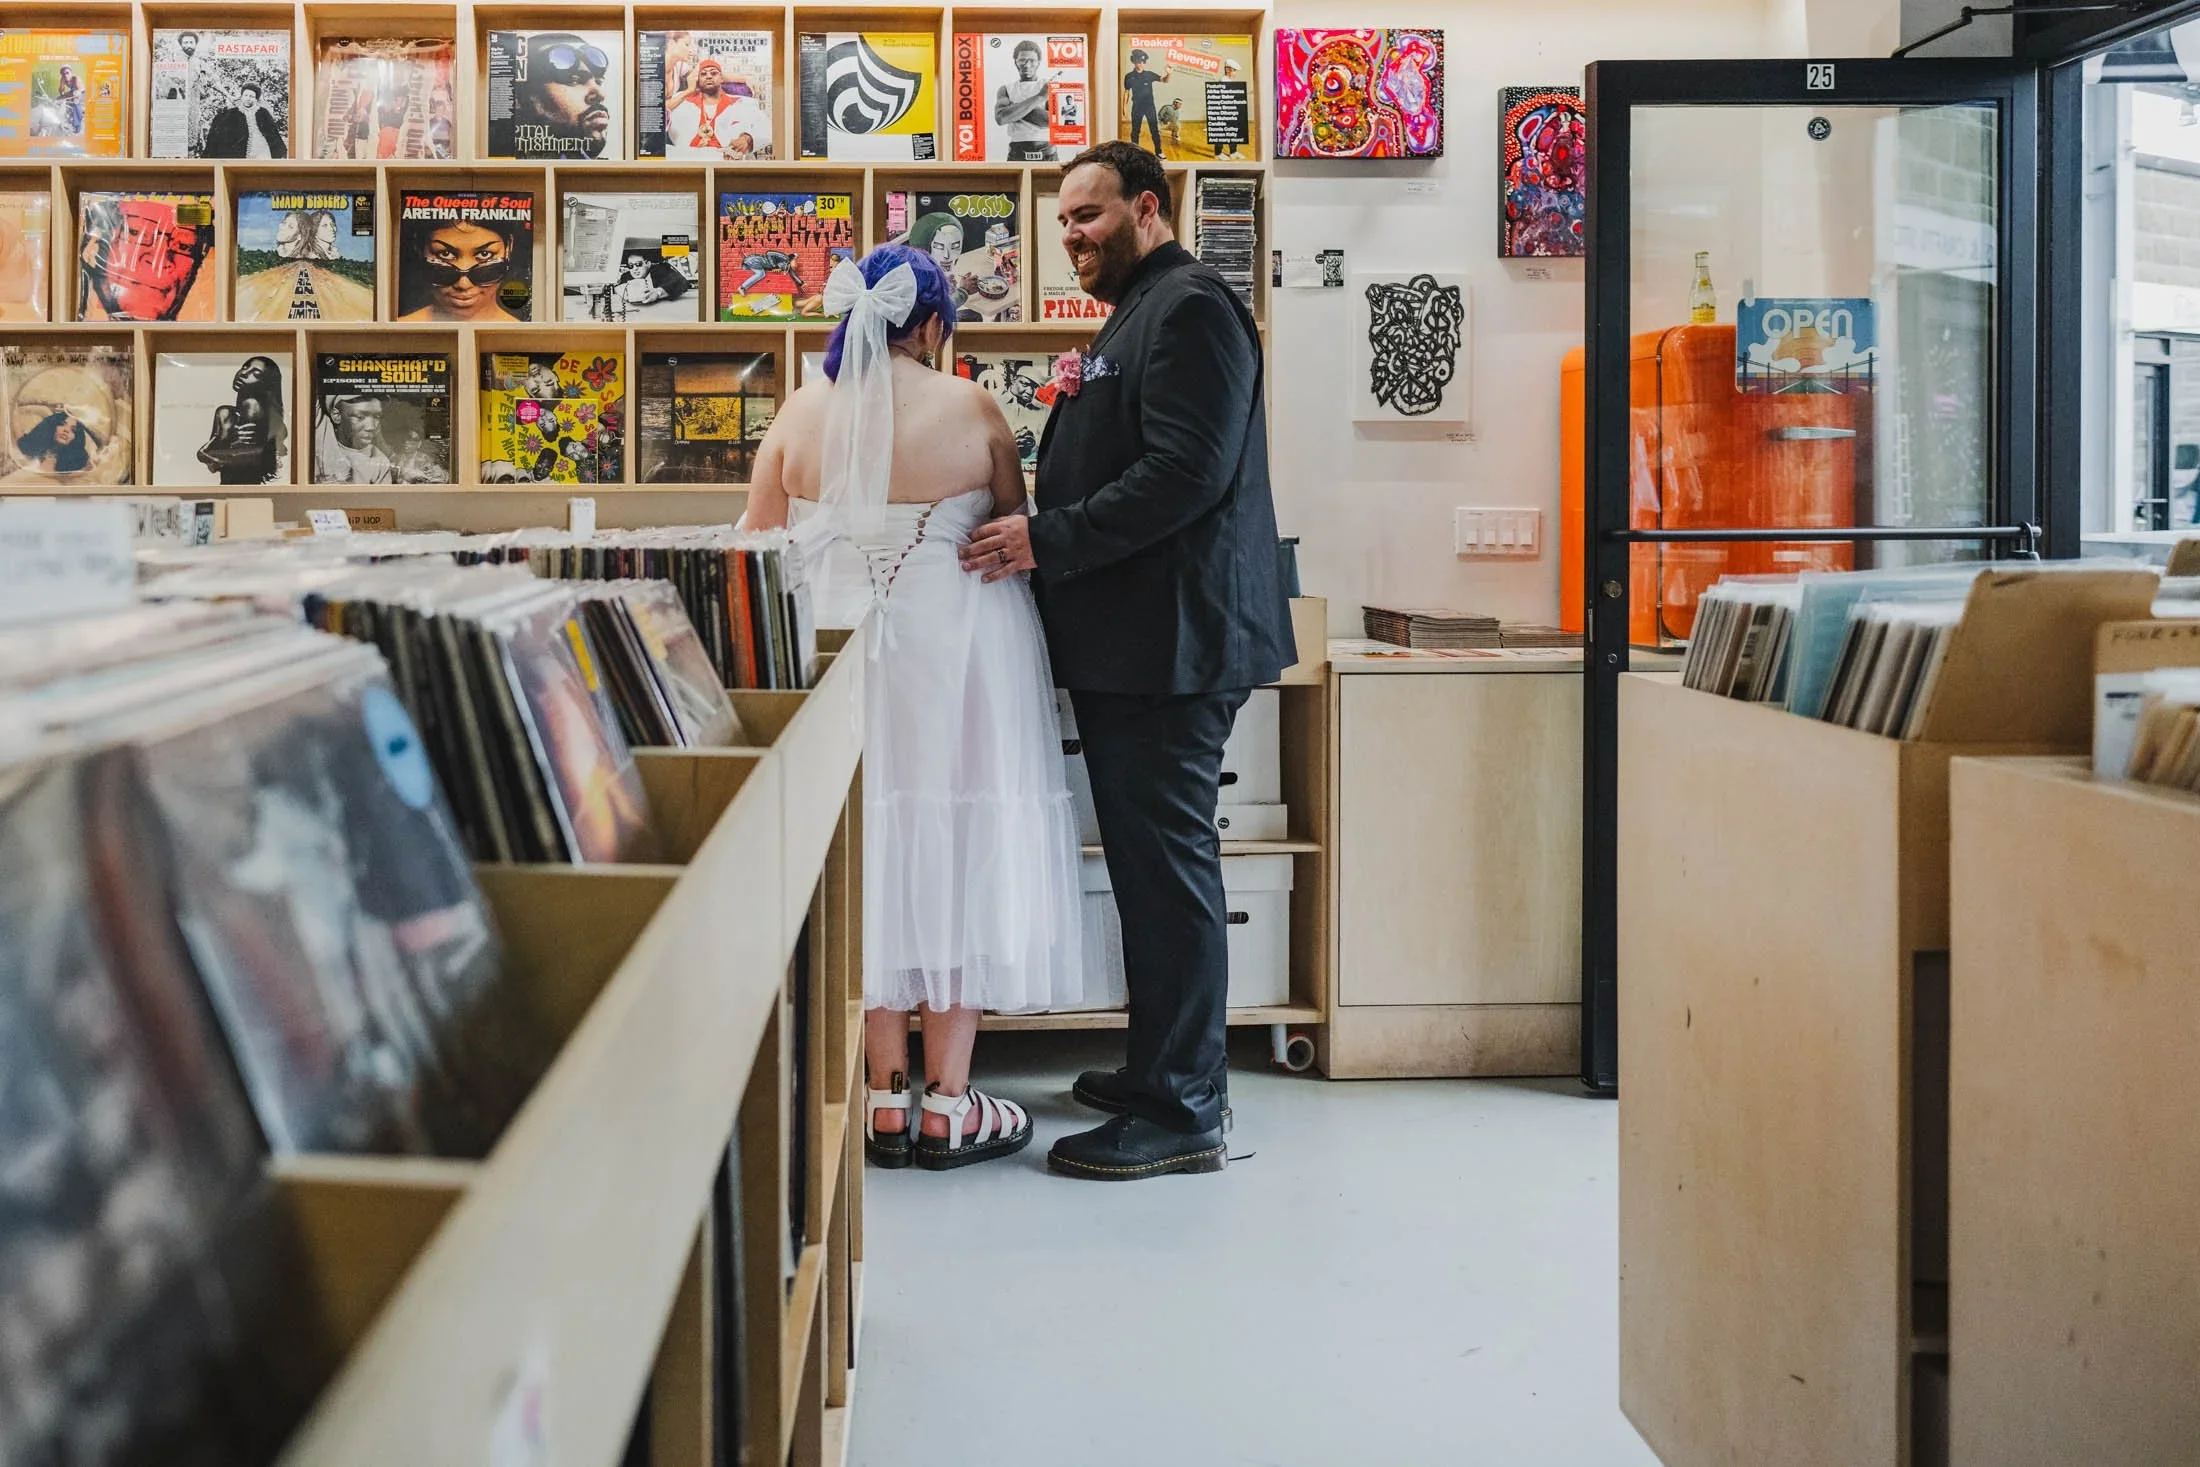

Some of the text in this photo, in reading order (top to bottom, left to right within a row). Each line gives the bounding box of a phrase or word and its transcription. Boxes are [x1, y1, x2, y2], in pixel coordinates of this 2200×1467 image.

[217, 44, 279, 54] RASTAFARI
[699, 37, 768, 48] GHOSTFACE
[1131, 37, 1184, 48] Breaker's
[1048, 42, 1083, 58] YO!
[1167, 48, 1218, 70] Revenge
[958, 37, 973, 121] BOOMBOX
[1809, 65, 1832, 88] 25
[959, 124, 974, 154] YO!
[306, 194, 349, 210] SISTERS
[405, 196, 532, 209] The Queen of Soul
[402, 207, 532, 221] ARETHA FRANKLIN
[294, 286, 314, 295] ON
[291, 300, 318, 309] UN
[1761, 308, 1853, 339] OPEN
[338, 360, 447, 372] SHANGHAI'D
[559, 358, 581, 374] DE
[380, 371, 428, 384] SOUL
[363, 516, 382, 525] HOP
